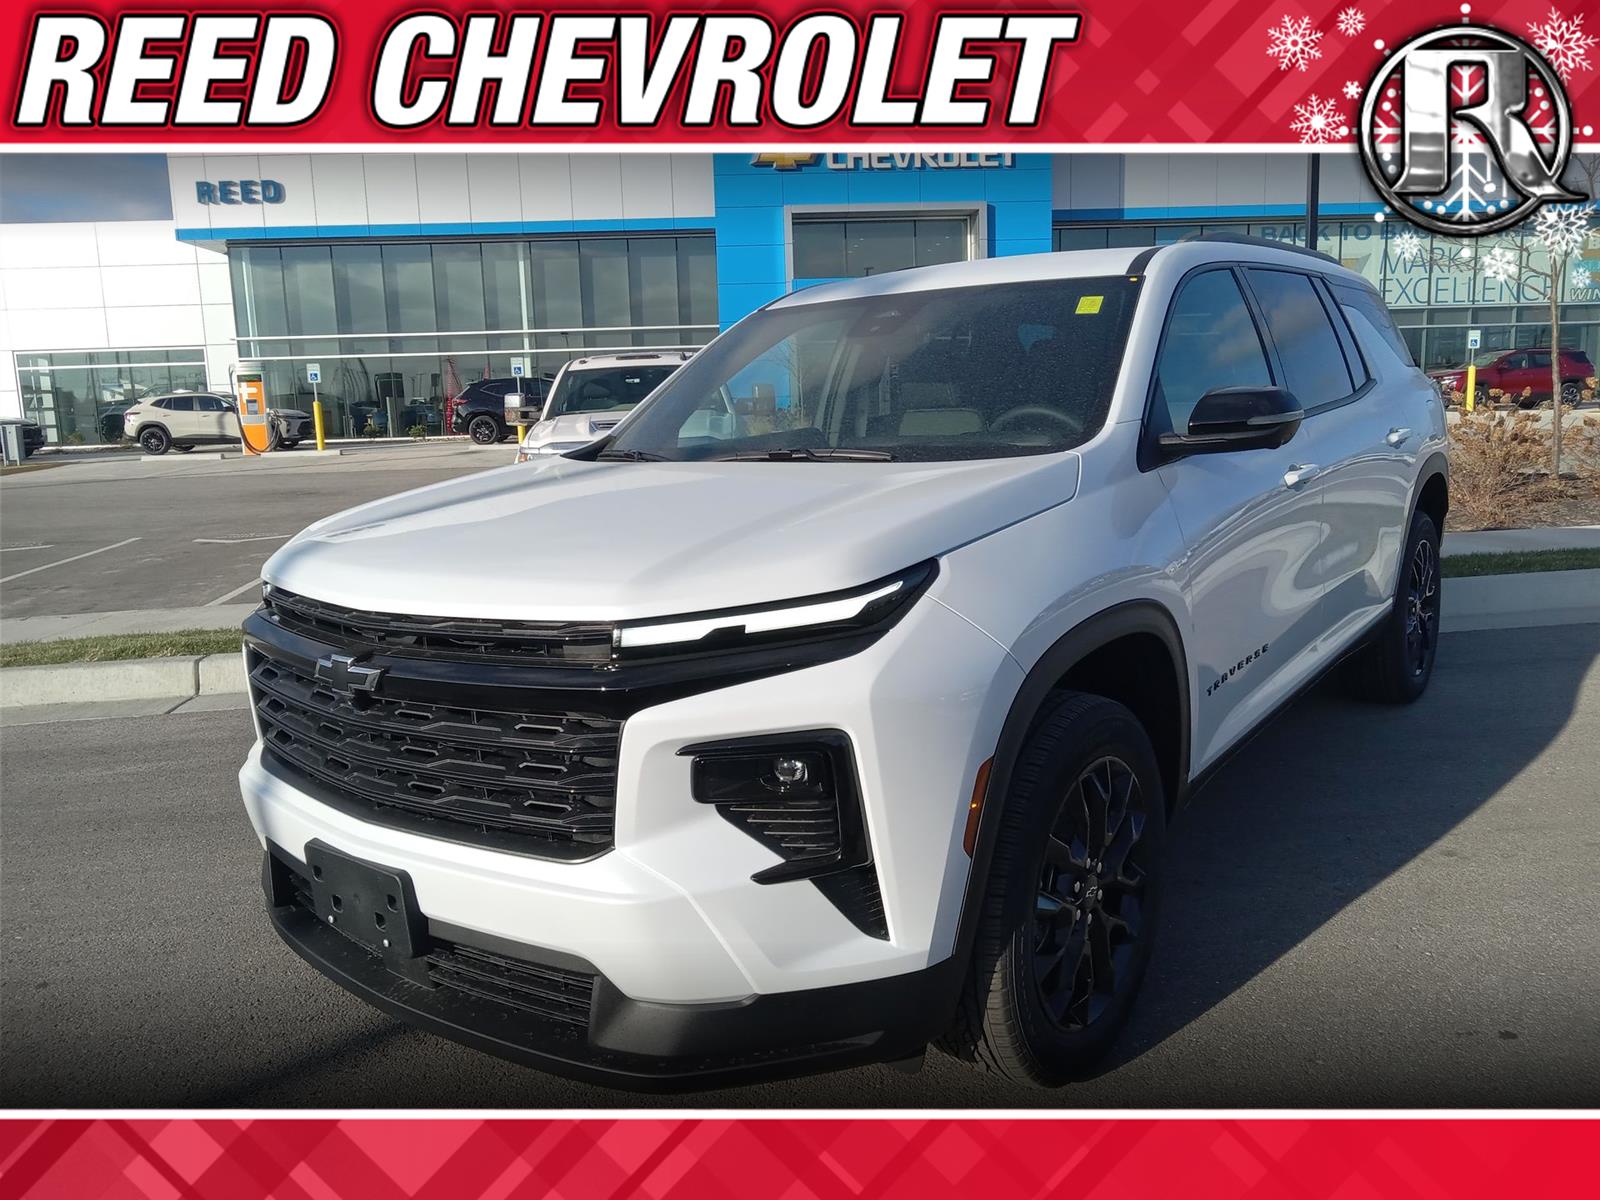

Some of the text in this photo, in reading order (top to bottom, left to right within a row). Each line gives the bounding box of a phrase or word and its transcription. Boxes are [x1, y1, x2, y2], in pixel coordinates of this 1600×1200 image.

[196, 180, 286, 205] REED
[1261, 224, 1331, 242] BACK
[1342, 224, 1372, 241] TO
[1206, 643, 1269, 696] TRAVERSE
